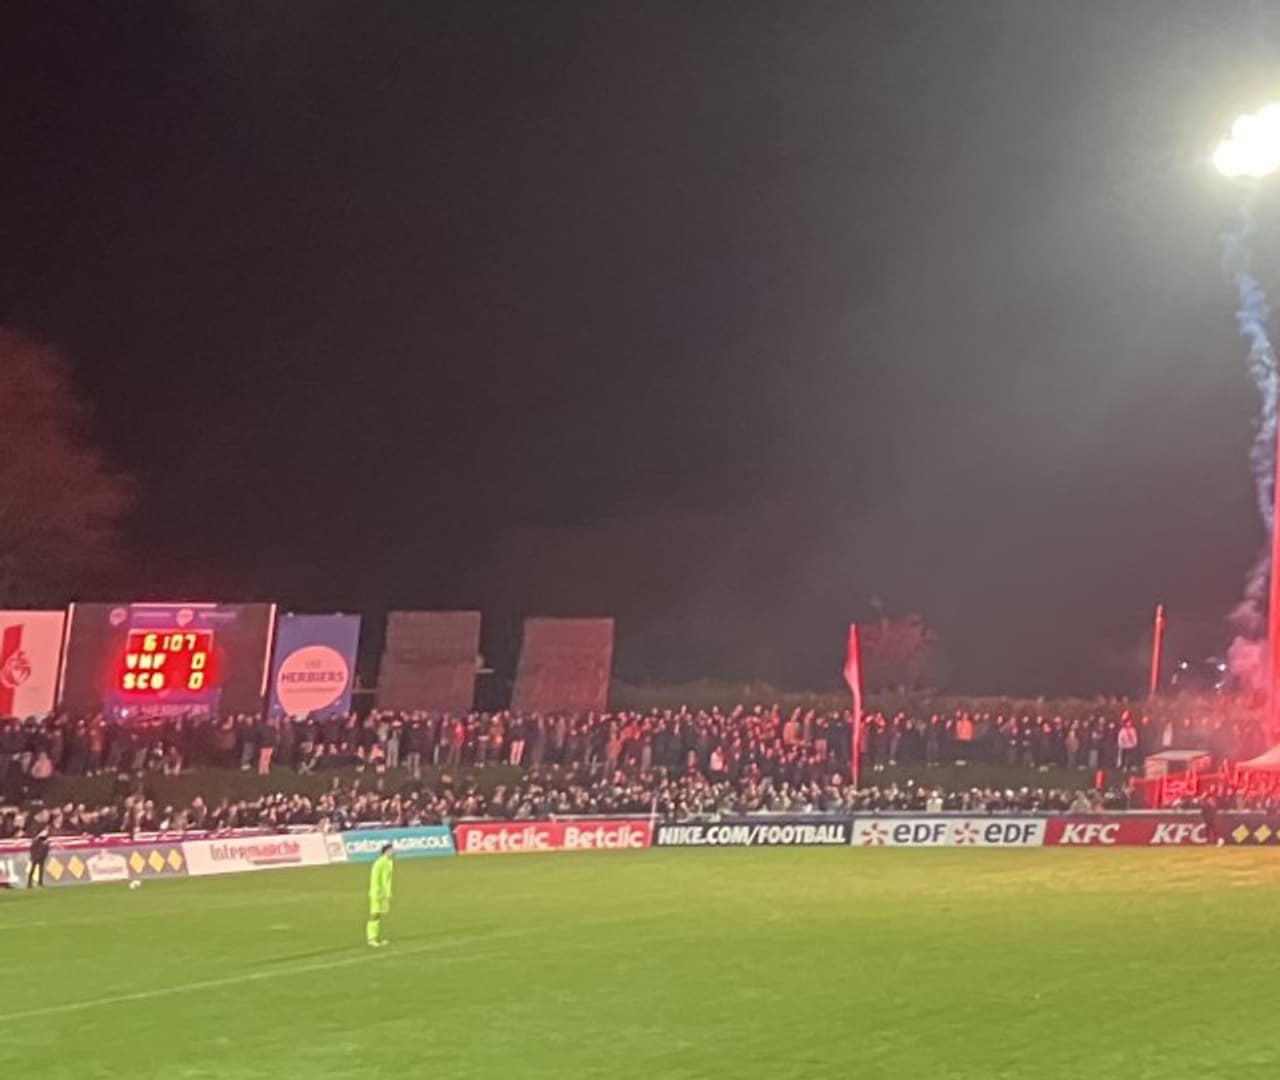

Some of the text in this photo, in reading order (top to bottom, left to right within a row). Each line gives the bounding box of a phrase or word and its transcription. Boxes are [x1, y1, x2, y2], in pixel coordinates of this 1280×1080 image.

[190, 652, 206, 670] 0
[187, 671, 204, 690] 0
[281, 671, 344, 683] HERBIERS
[465, 828, 548, 851] Betclic
[562, 826, 642, 848] Betclic
[658, 824, 845, 845] NIKE.COM/FOOTBALL
[1060, 823, 1120, 843] KFC
[1150, 823, 1206, 843] KFC
